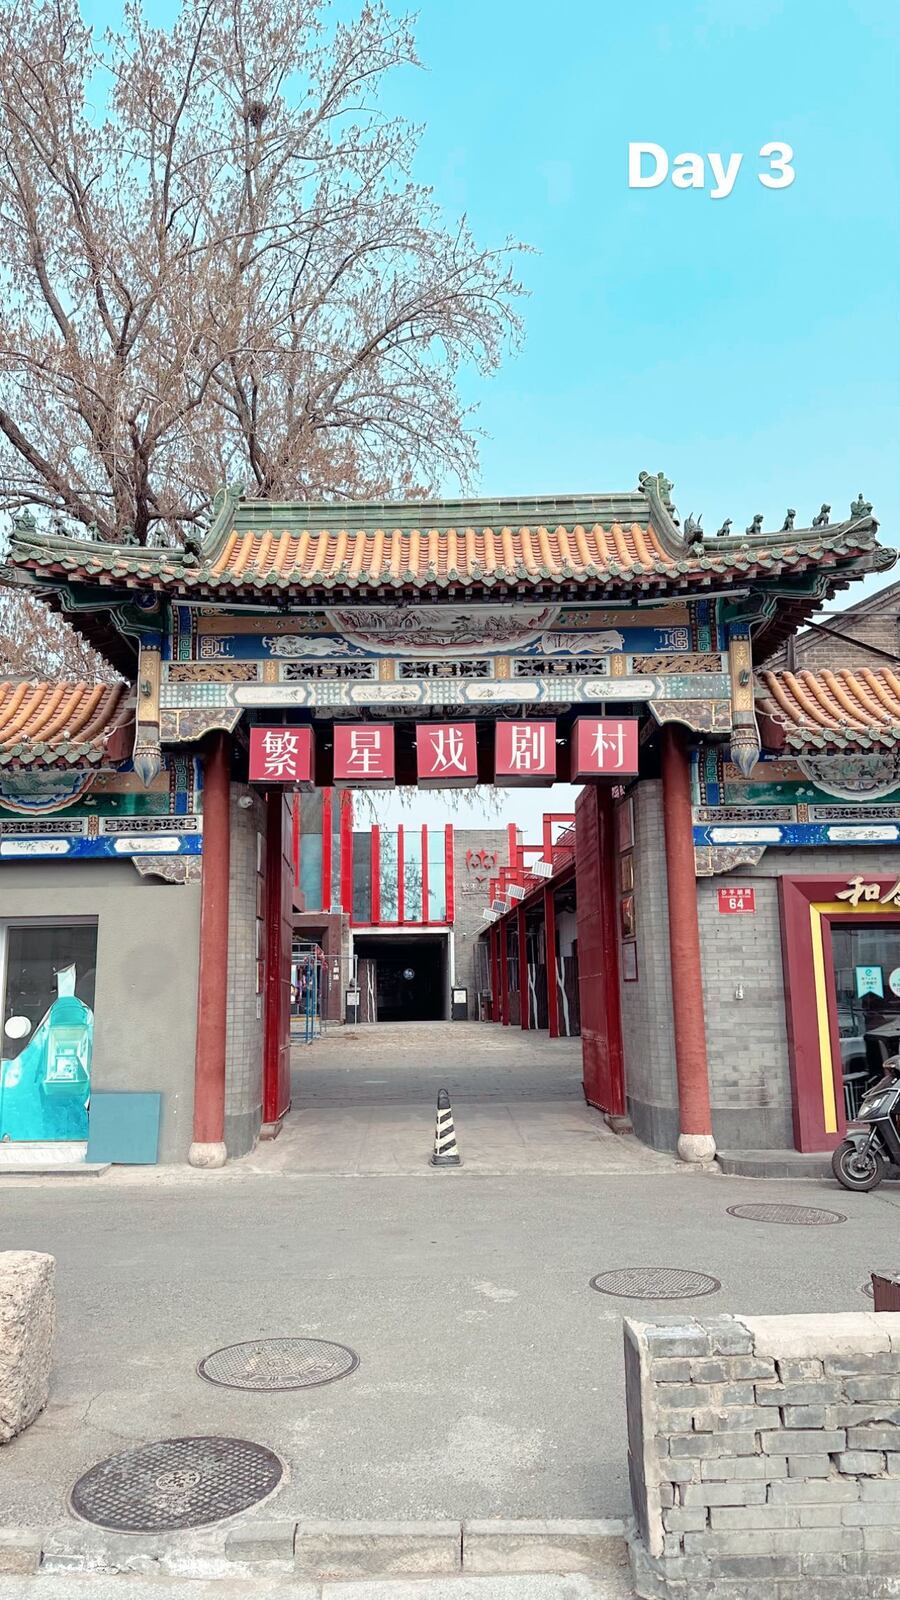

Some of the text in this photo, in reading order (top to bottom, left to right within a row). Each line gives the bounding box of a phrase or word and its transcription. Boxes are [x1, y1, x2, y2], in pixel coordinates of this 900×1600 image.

[262, 723, 628, 777] 繁星戏剧村
